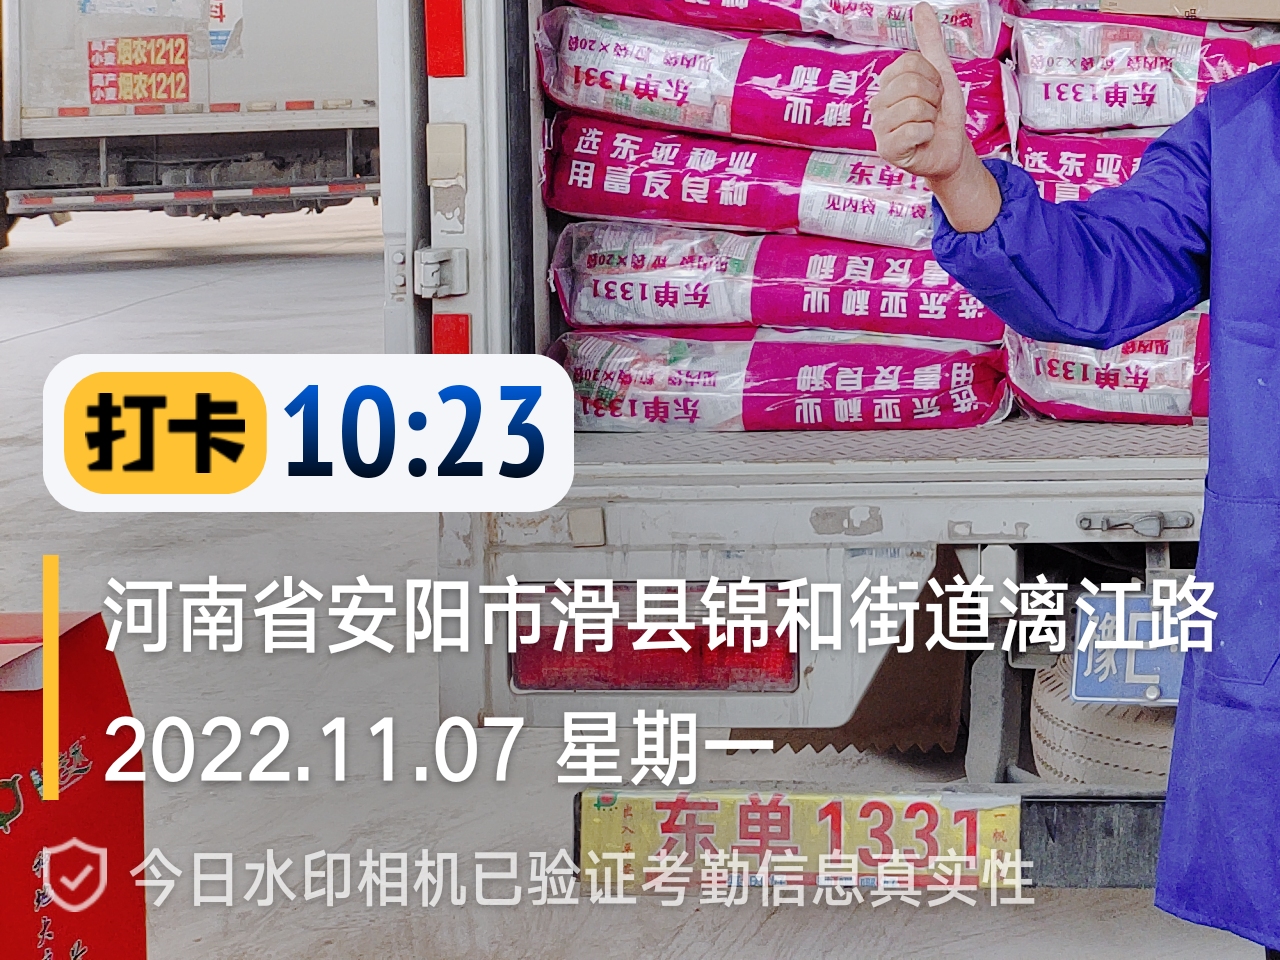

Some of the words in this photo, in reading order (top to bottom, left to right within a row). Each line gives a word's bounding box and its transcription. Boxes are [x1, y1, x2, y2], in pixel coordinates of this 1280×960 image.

[573, 65, 692, 107] 东单1331
[1042, 82, 1158, 108] 东单1331
[573, 127, 758, 177] 选东亚种业
[568, 159, 749, 207] 用富友良种
[805, 254, 950, 287] 富友良种
[592, 279, 711, 309] 东单1331
[796, 361, 976, 391] 用富友良种
[1034, 356, 1150, 393] 东单1331
[579, 396, 702, 424] 东单1331
[795, 385, 979, 425] 选东亚种业
